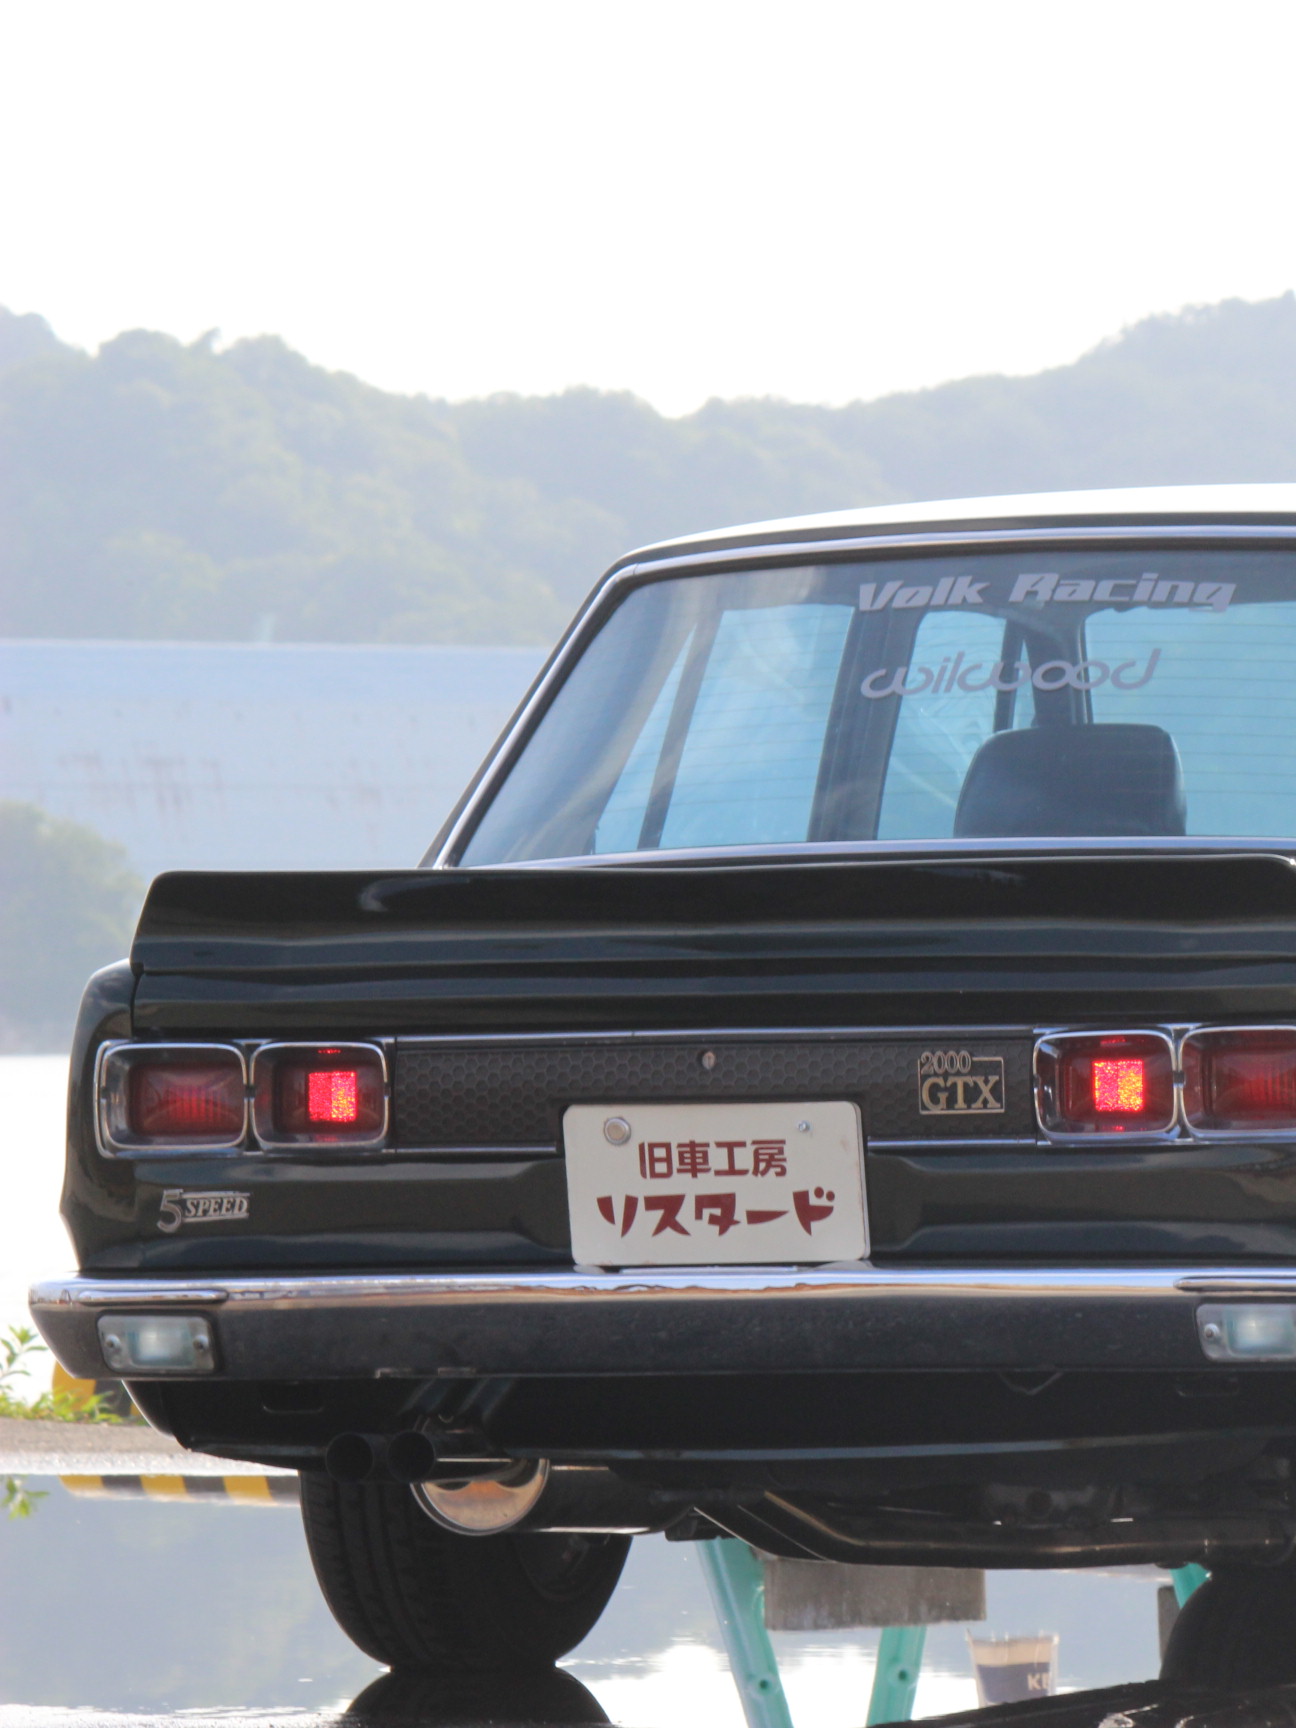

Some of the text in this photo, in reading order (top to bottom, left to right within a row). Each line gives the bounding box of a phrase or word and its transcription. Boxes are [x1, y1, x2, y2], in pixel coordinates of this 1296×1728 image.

[858, 572, 1237, 613] Volk Racing
[860, 648, 1162, 699] wilwood
[920, 1050, 972, 1075] 2000
[922, 1075, 1001, 1112] GTX
[638, 1139, 787, 1180] 旧車工房
[156, 1188, 249, 1234] 5 SPEED
[596, 1186, 836, 1238] リスタード
